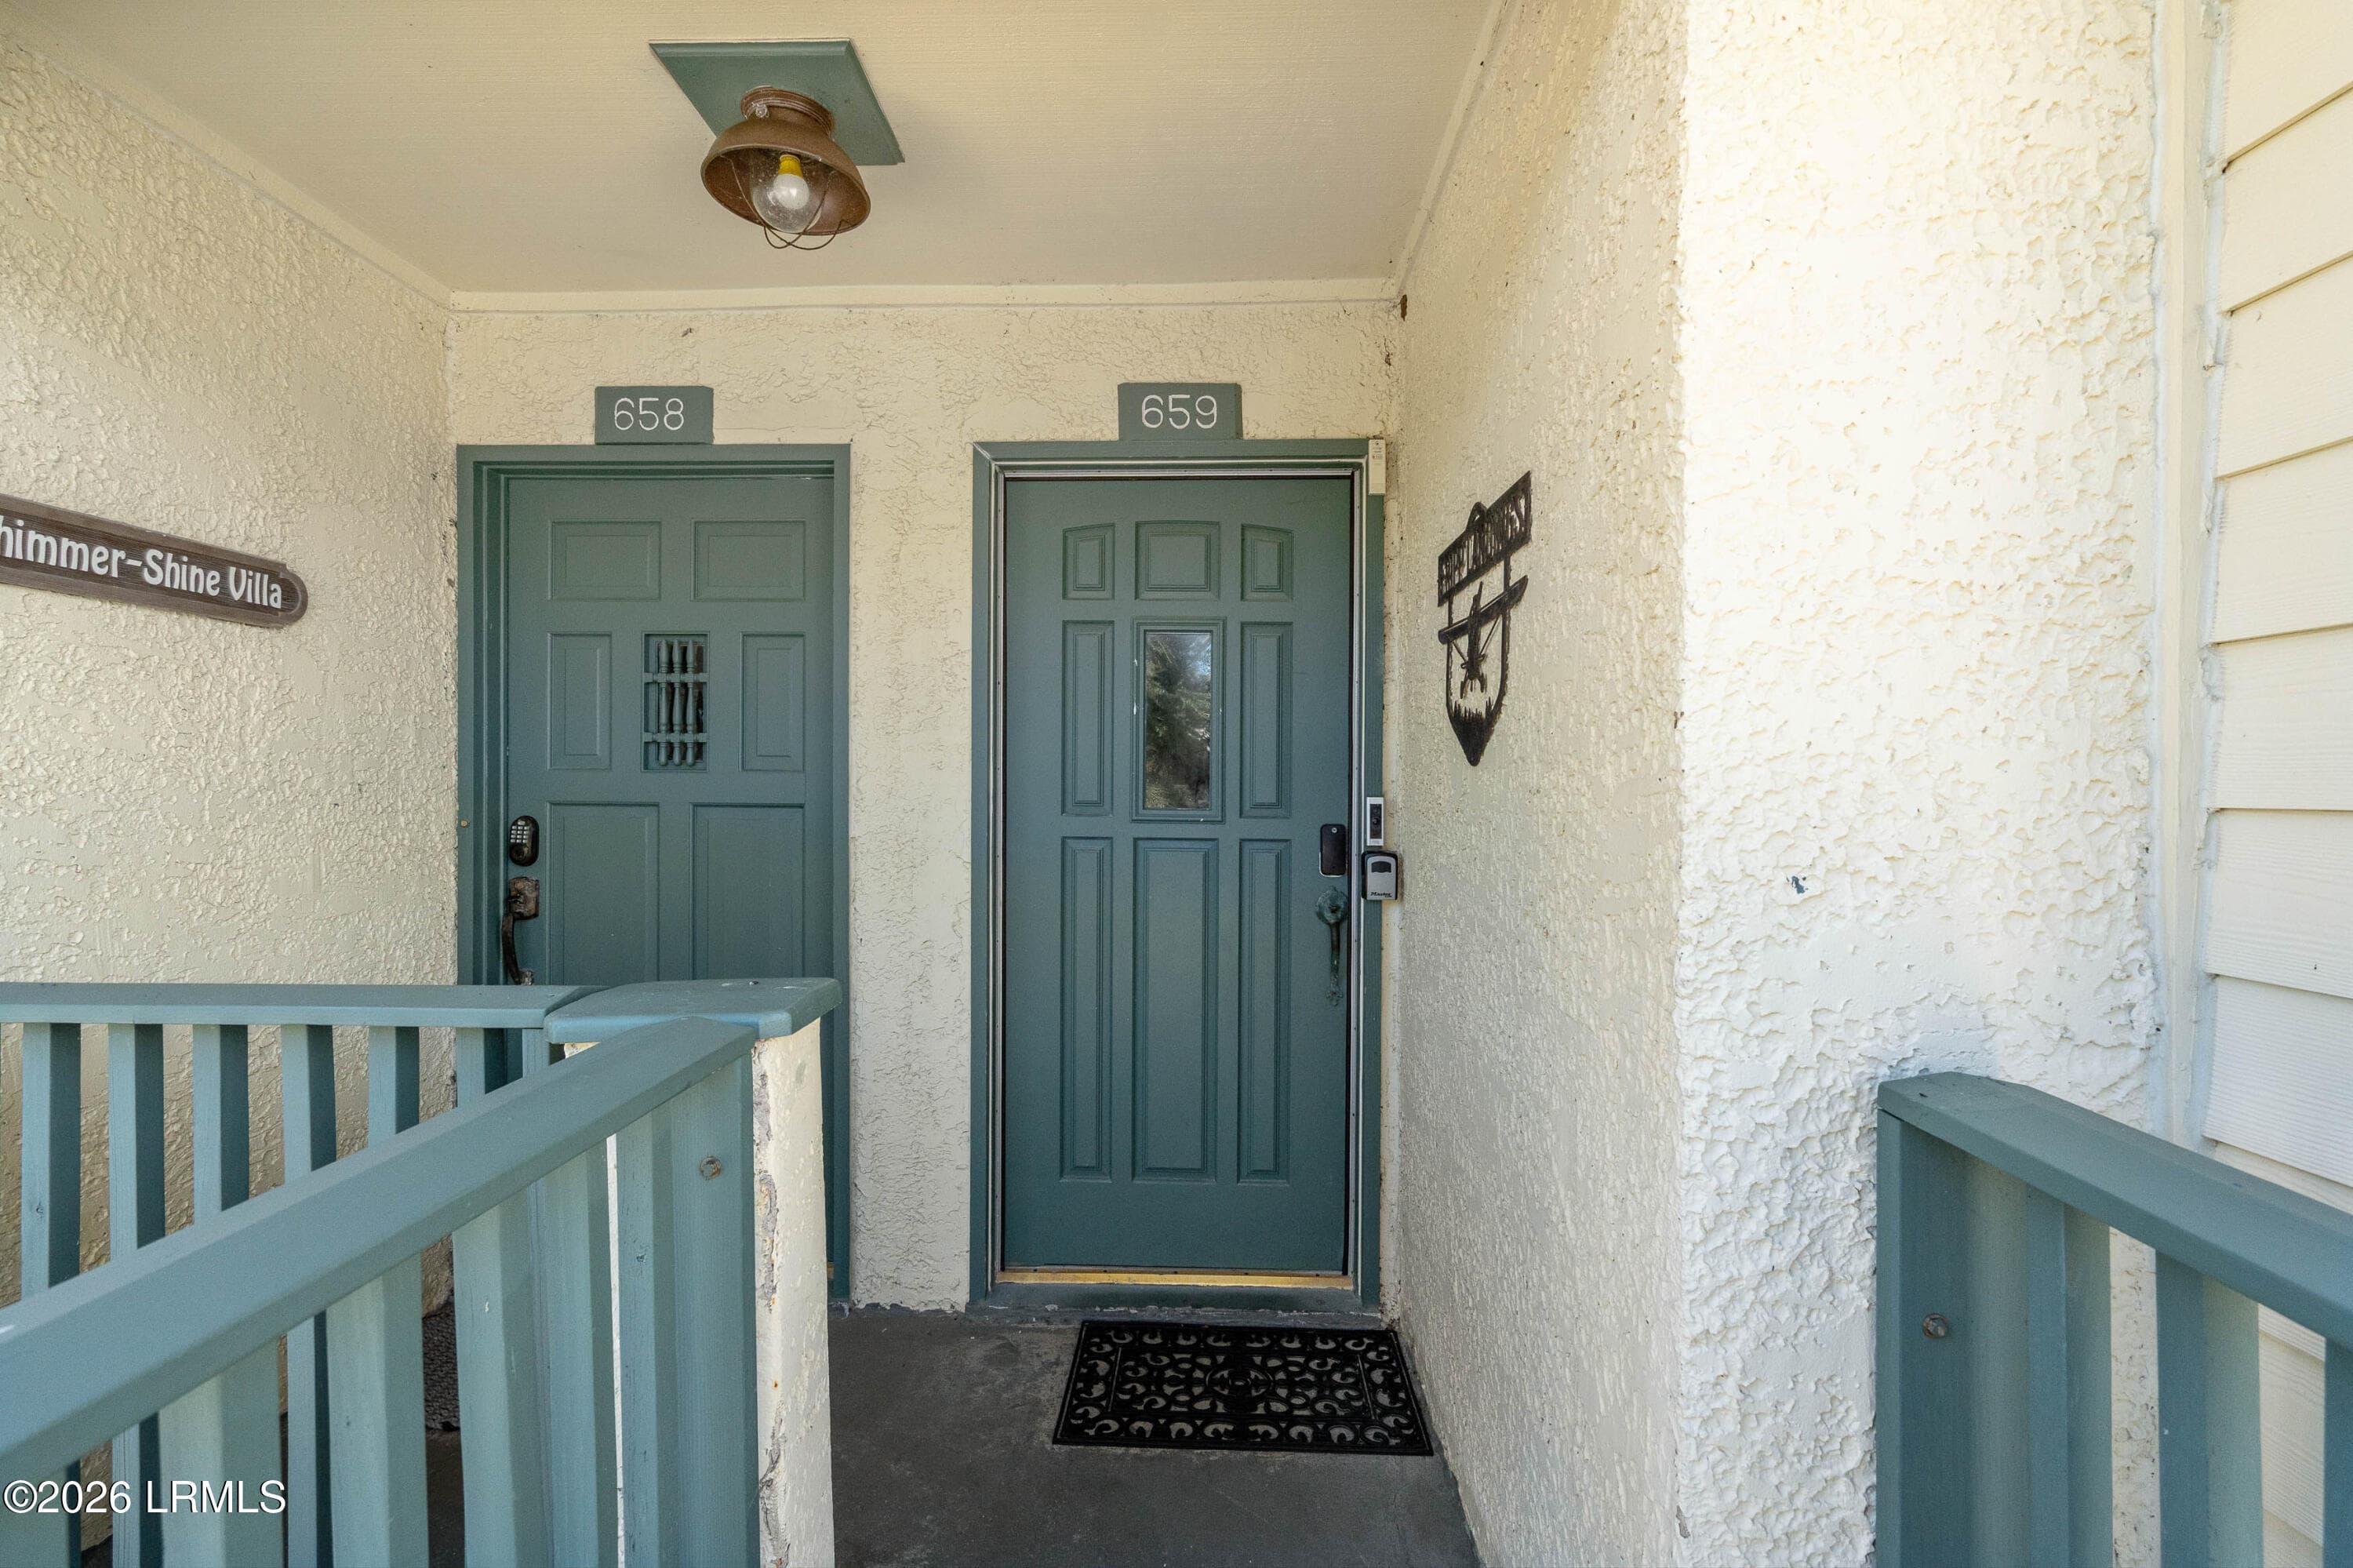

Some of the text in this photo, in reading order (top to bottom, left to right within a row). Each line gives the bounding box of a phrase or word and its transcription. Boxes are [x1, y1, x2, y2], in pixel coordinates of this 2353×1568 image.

[614, 397, 685, 431] 658
[1141, 394, 1217, 430] 659
[228, 566, 282, 609] Villa
